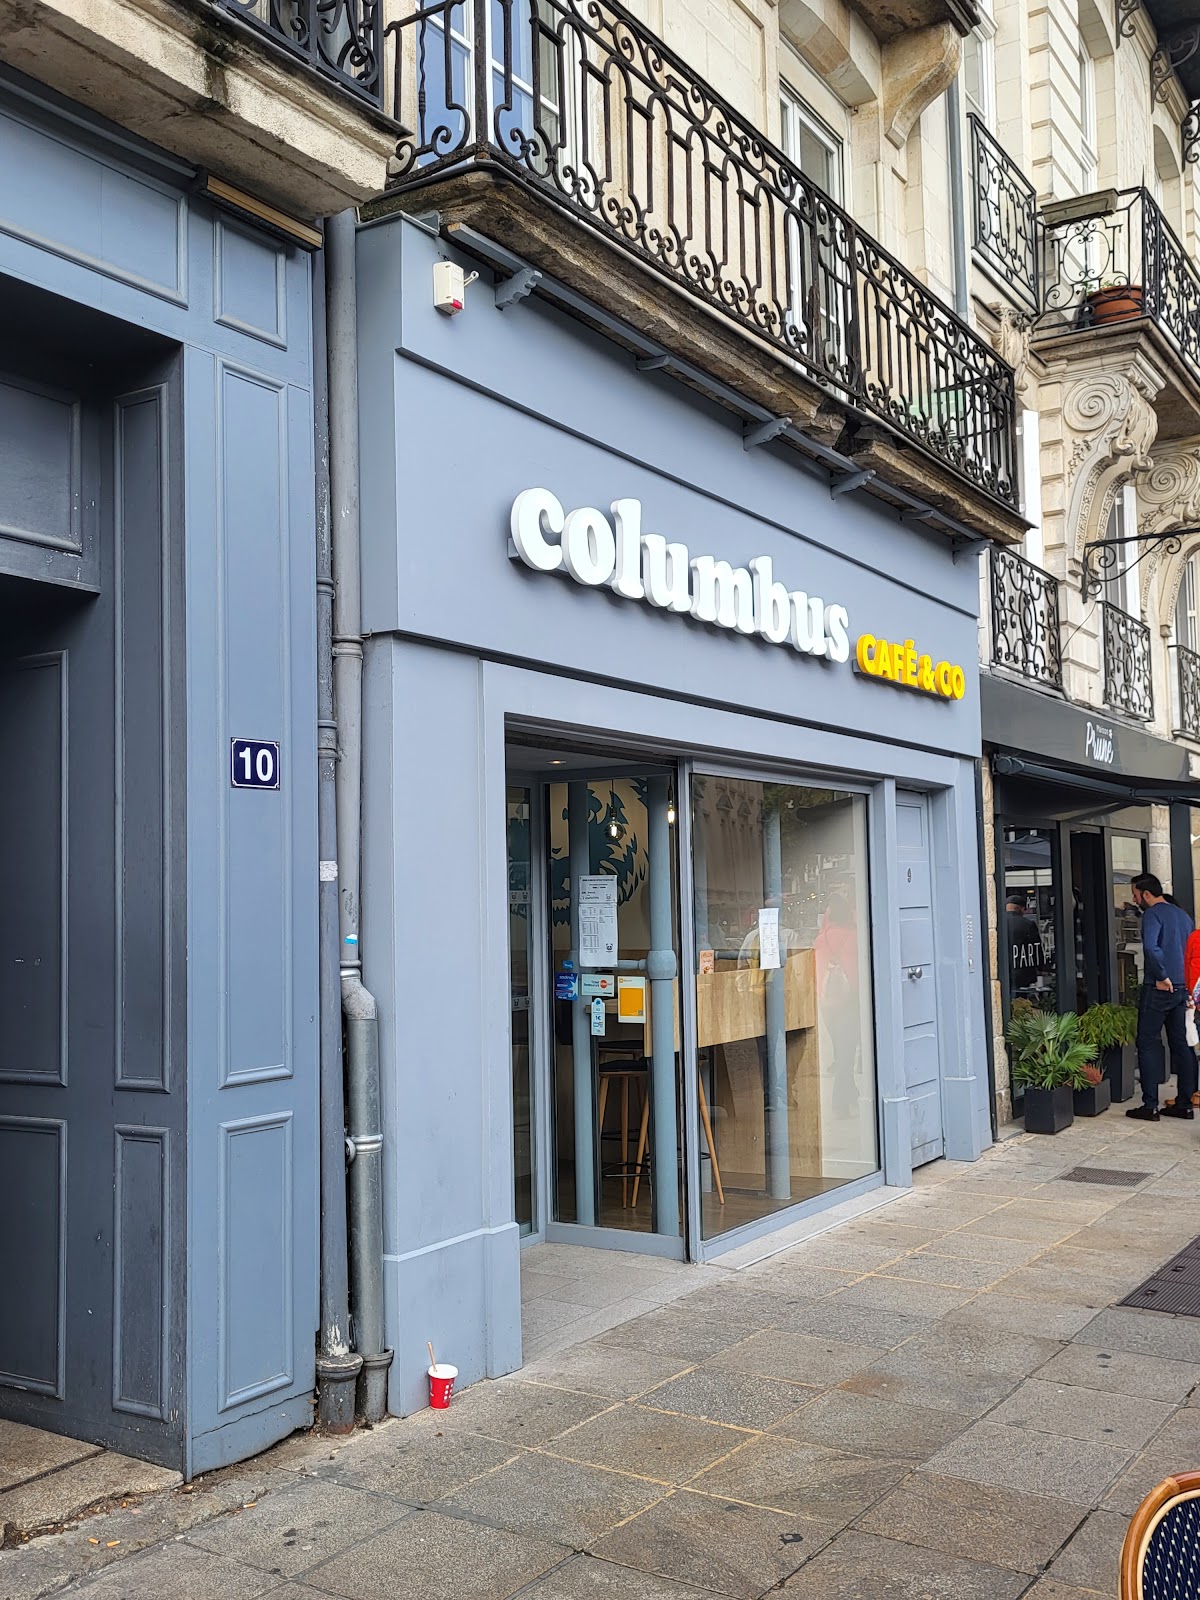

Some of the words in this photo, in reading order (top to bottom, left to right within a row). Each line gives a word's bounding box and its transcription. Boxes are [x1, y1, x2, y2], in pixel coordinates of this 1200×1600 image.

[511, 487, 850, 663] columbus
[1085, 721, 1114, 764] Prune
[239, 747, 273, 782] 10
[907, 867, 912, 883] 9
